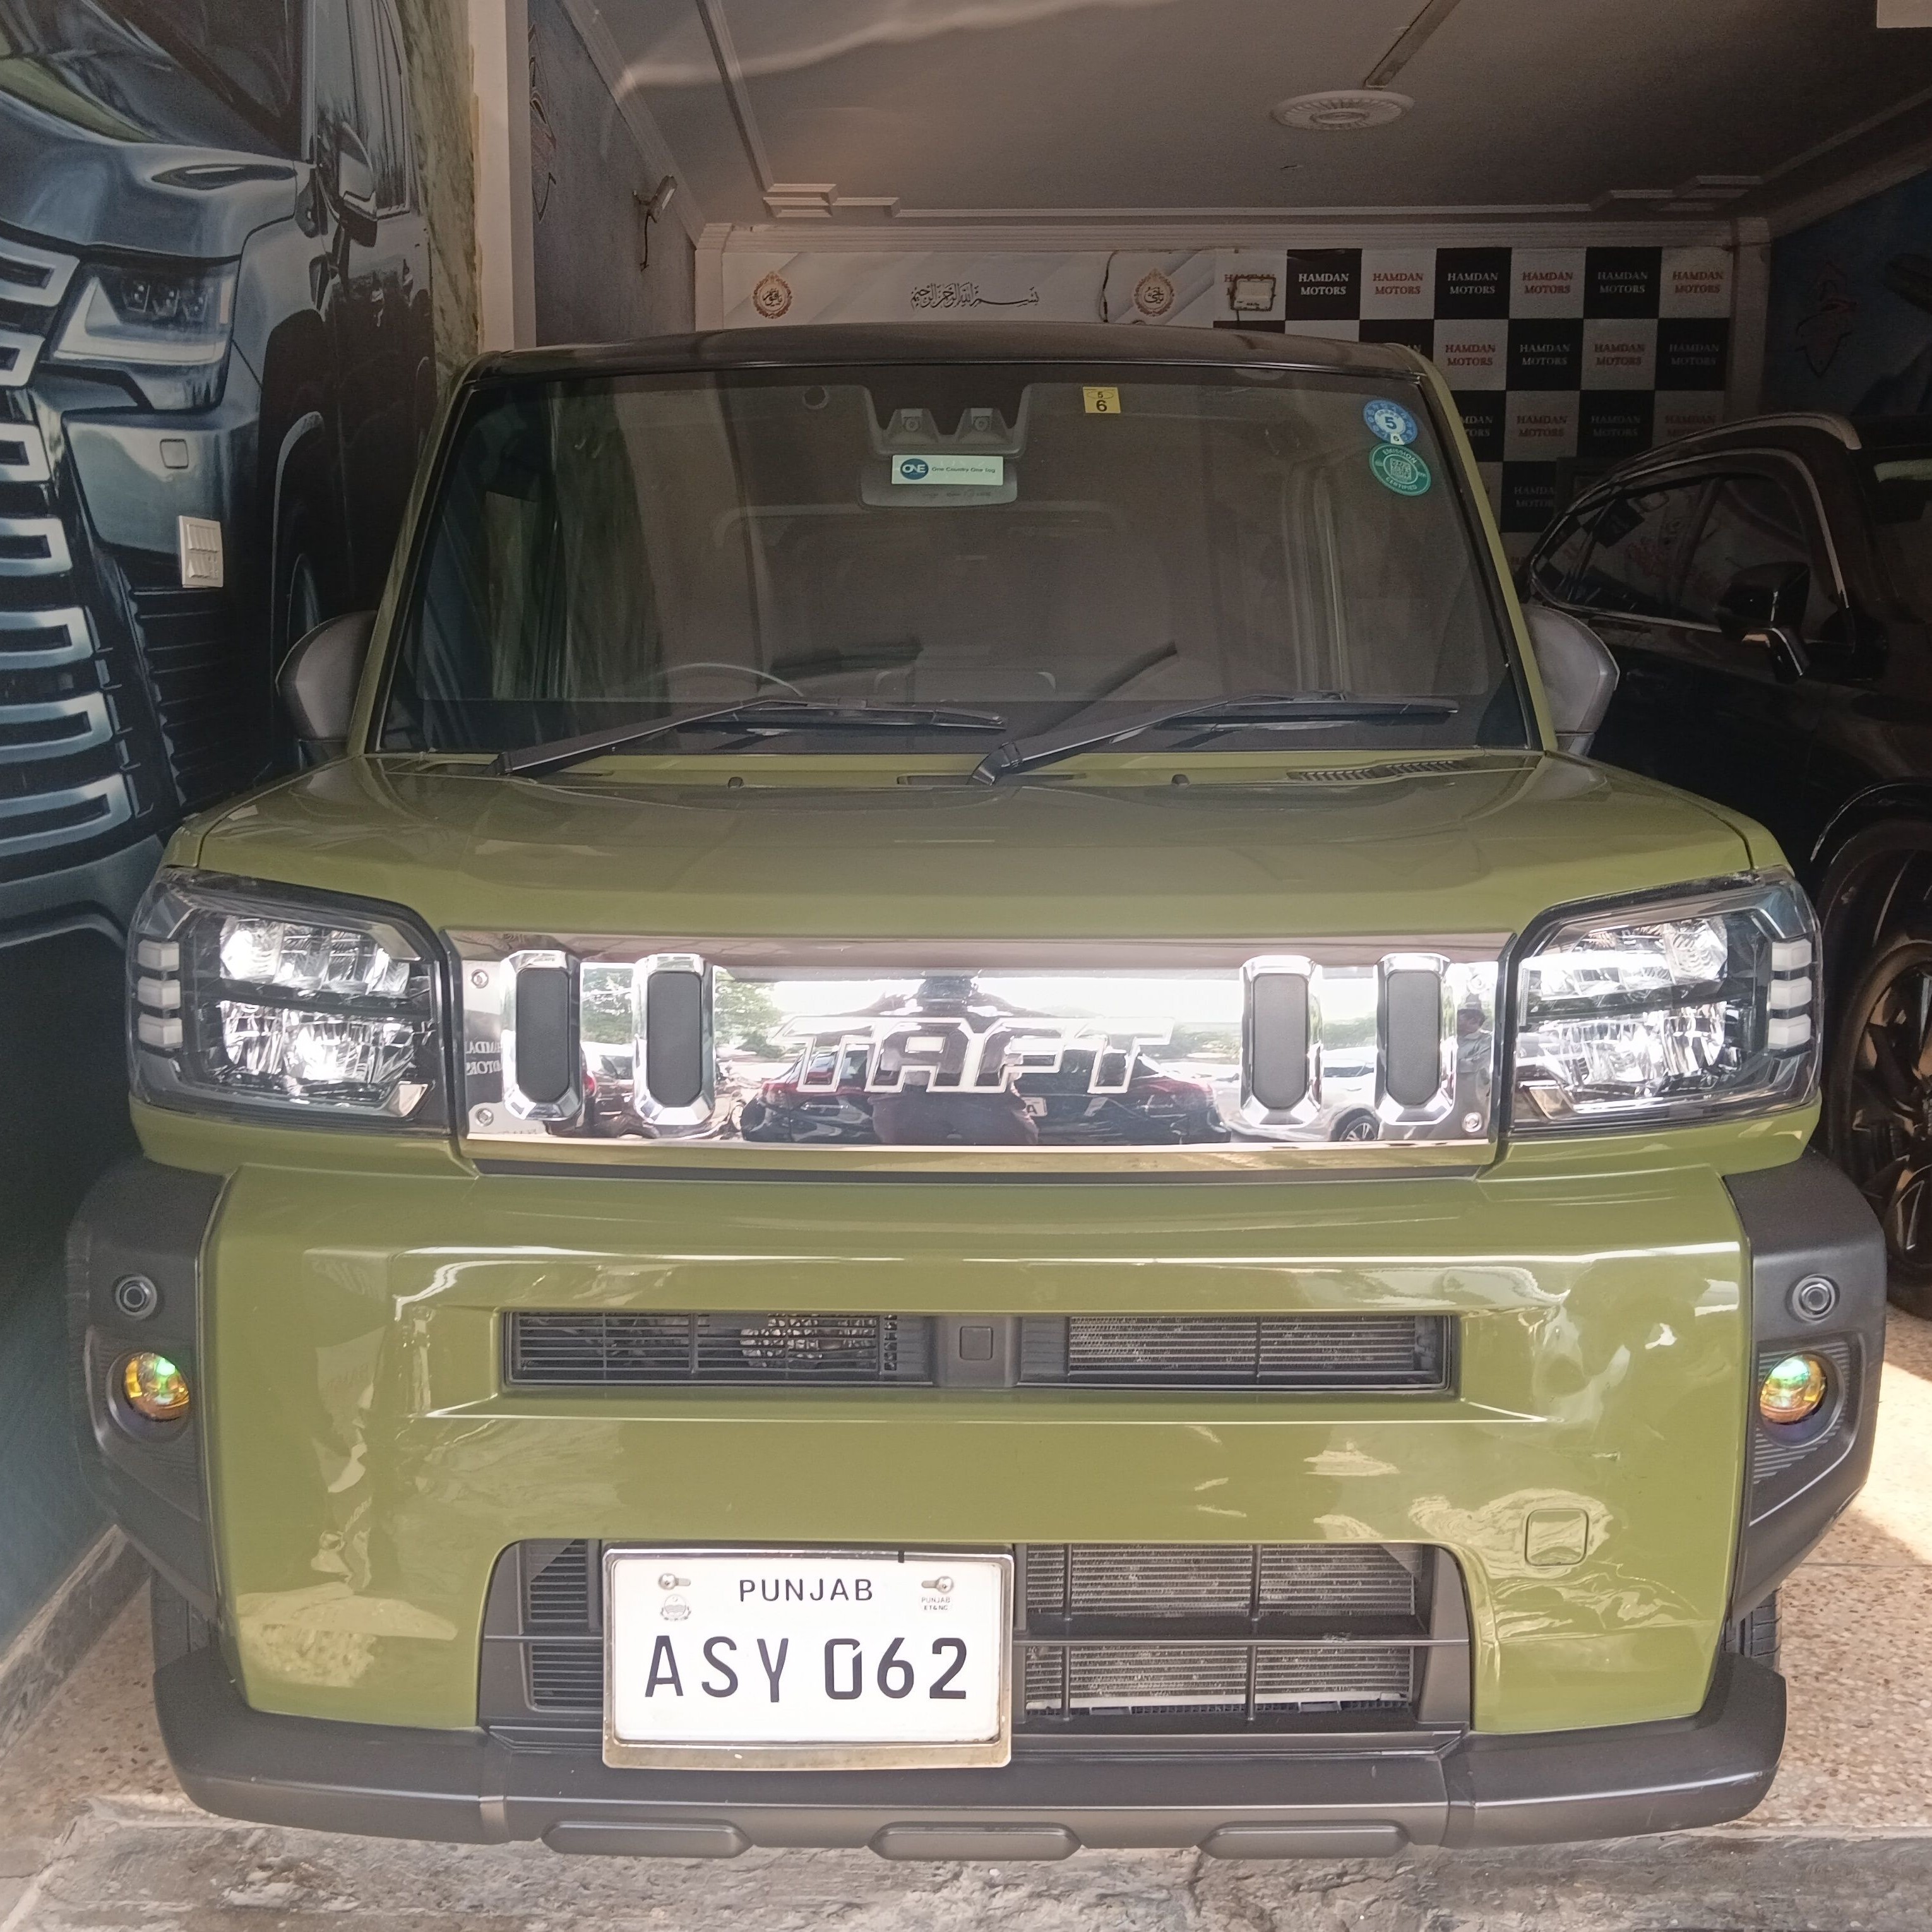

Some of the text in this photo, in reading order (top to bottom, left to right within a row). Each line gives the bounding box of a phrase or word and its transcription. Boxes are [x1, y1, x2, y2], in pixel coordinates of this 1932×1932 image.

[1299, 273, 1349, 282] HAMDAN
[1373, 273, 1424, 282] HAMDAN
[1448, 272, 1498, 281] HAMDAN
[1522, 271, 1573, 281] HAMDAN
[1597, 271, 1648, 280] HAMDAN
[1673, 271, 1724, 280] HAMDAN
[1301, 286, 1347, 295] MOTORS
[1375, 286, 1421, 294] MOTORS
[1450, 285, 1496, 294] MOTORS
[1525, 285, 1571, 294] MOTORS
[1599, 285, 1645, 293] MOTORS
[1675, 284, 1720, 294] MOTORS
[1446, 344, 1496, 353] HAMDAN
[1519, 343, 1571, 352] HAMDAN
[1594, 343, 1645, 352] HAMDAN
[1669, 343, 1719, 352] HAMDAN
[1448, 357, 1493, 366] MOTORS
[1522, 357, 1567, 366] MOTORS
[1596, 356, 1642, 366] MOTORS
[1671, 357, 1717, 365] MOTORS
[1097, 400, 1107, 412] 6
[1385, 416, 1397, 430] 5
[1517, 415, 1568, 424] HAMDAN
[902, 464, 926, 474] ONE
[1514, 486, 1556, 494] HAMDA
[766, 1015, 1176, 1094] TAFT
[739, 1578, 874, 1602] PUNJAB
[644, 1635, 967, 1703] ASY 062
